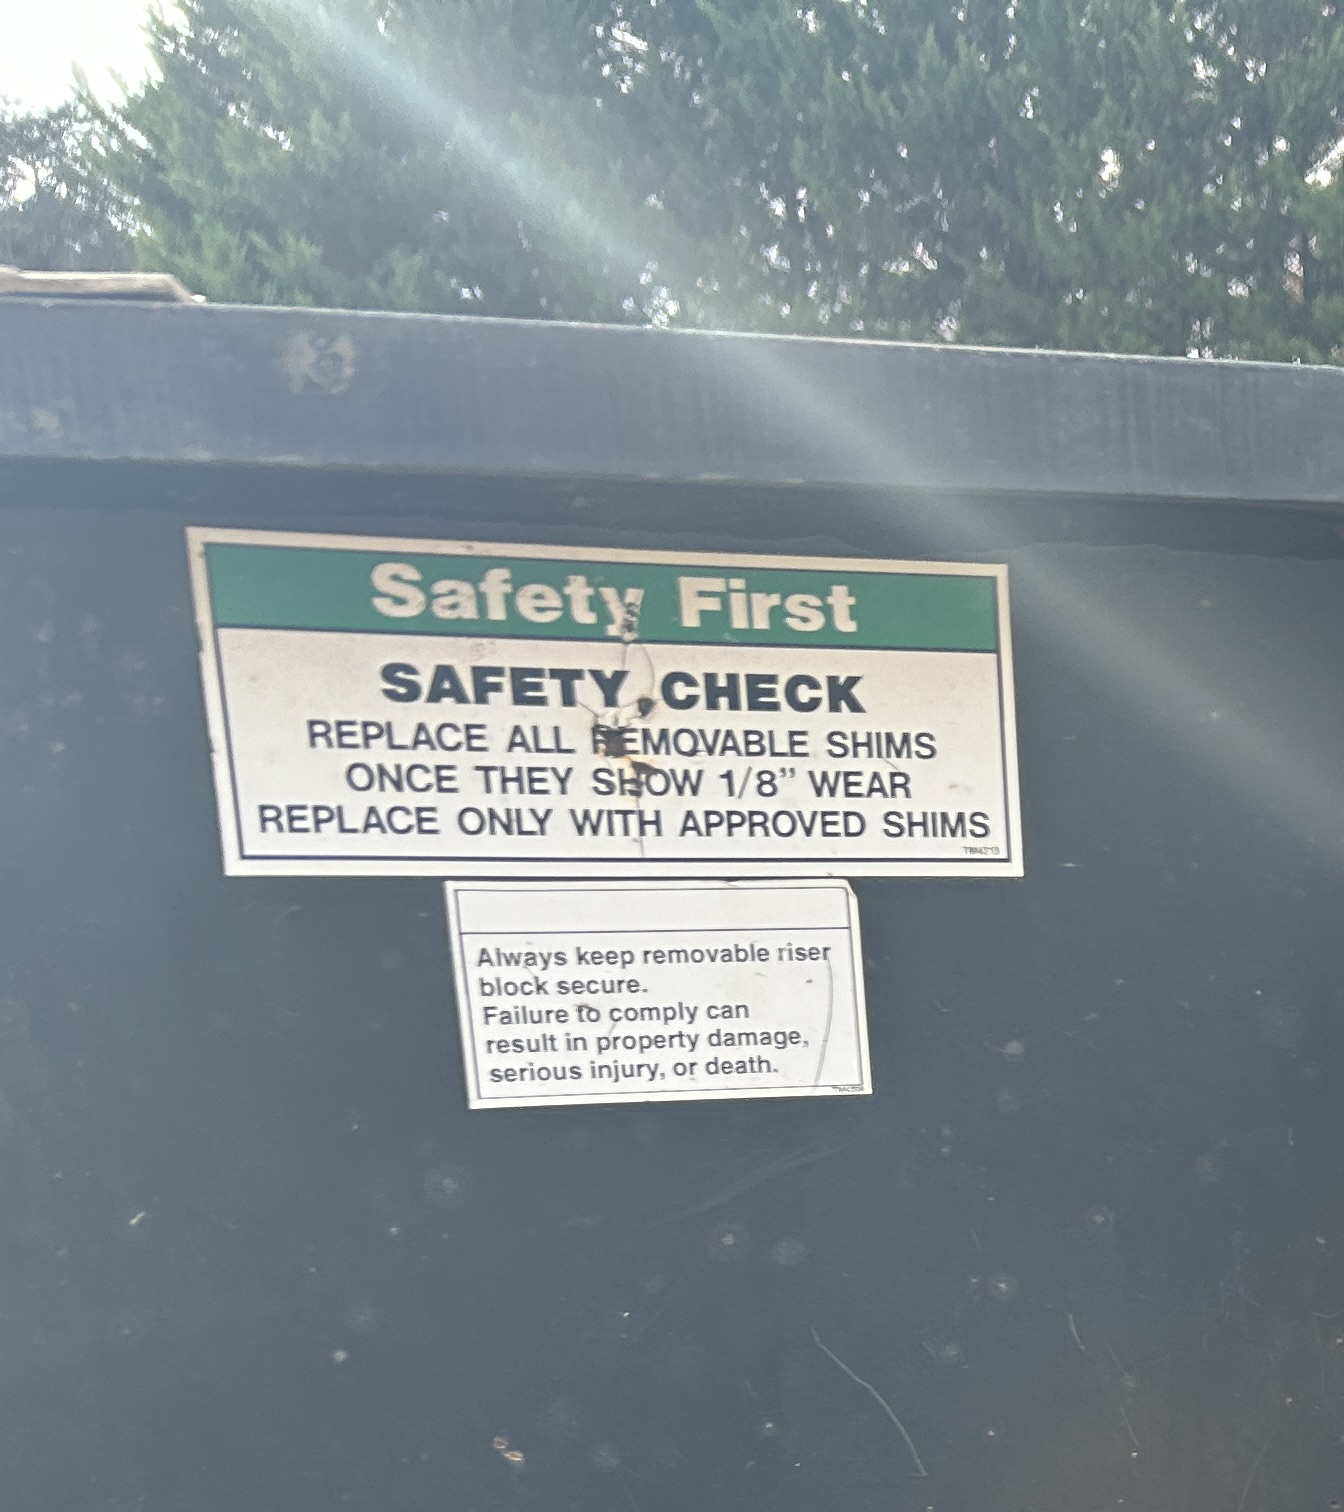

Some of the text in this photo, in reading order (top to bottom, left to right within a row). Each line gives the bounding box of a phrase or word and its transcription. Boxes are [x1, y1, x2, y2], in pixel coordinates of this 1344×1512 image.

[370, 562, 858, 639] Safety First
[379, 662, 868, 714] SAFETY CHECK
[307, 719, 490, 751] REPLACE
[506, 725, 577, 753] ALL
[826, 730, 937, 760] SHIMS
[346, 762, 459, 793] ONCE
[474, 766, 574, 795] THEY
[592, 768, 704, 797] SHOW
[808, 770, 912, 799] WEAR
[259, 804, 991, 838] REPLACE ONLY WITH APPROVED SHIMS
[477, 942, 832, 971] Always keep removable riser
[479, 976, 649, 997] block secure.
[483, 1001, 750, 1026] Failure to comply can
[486, 1028, 809, 1056] result in property damage,
[489, 1055, 779, 1083] serious injury, or death.
